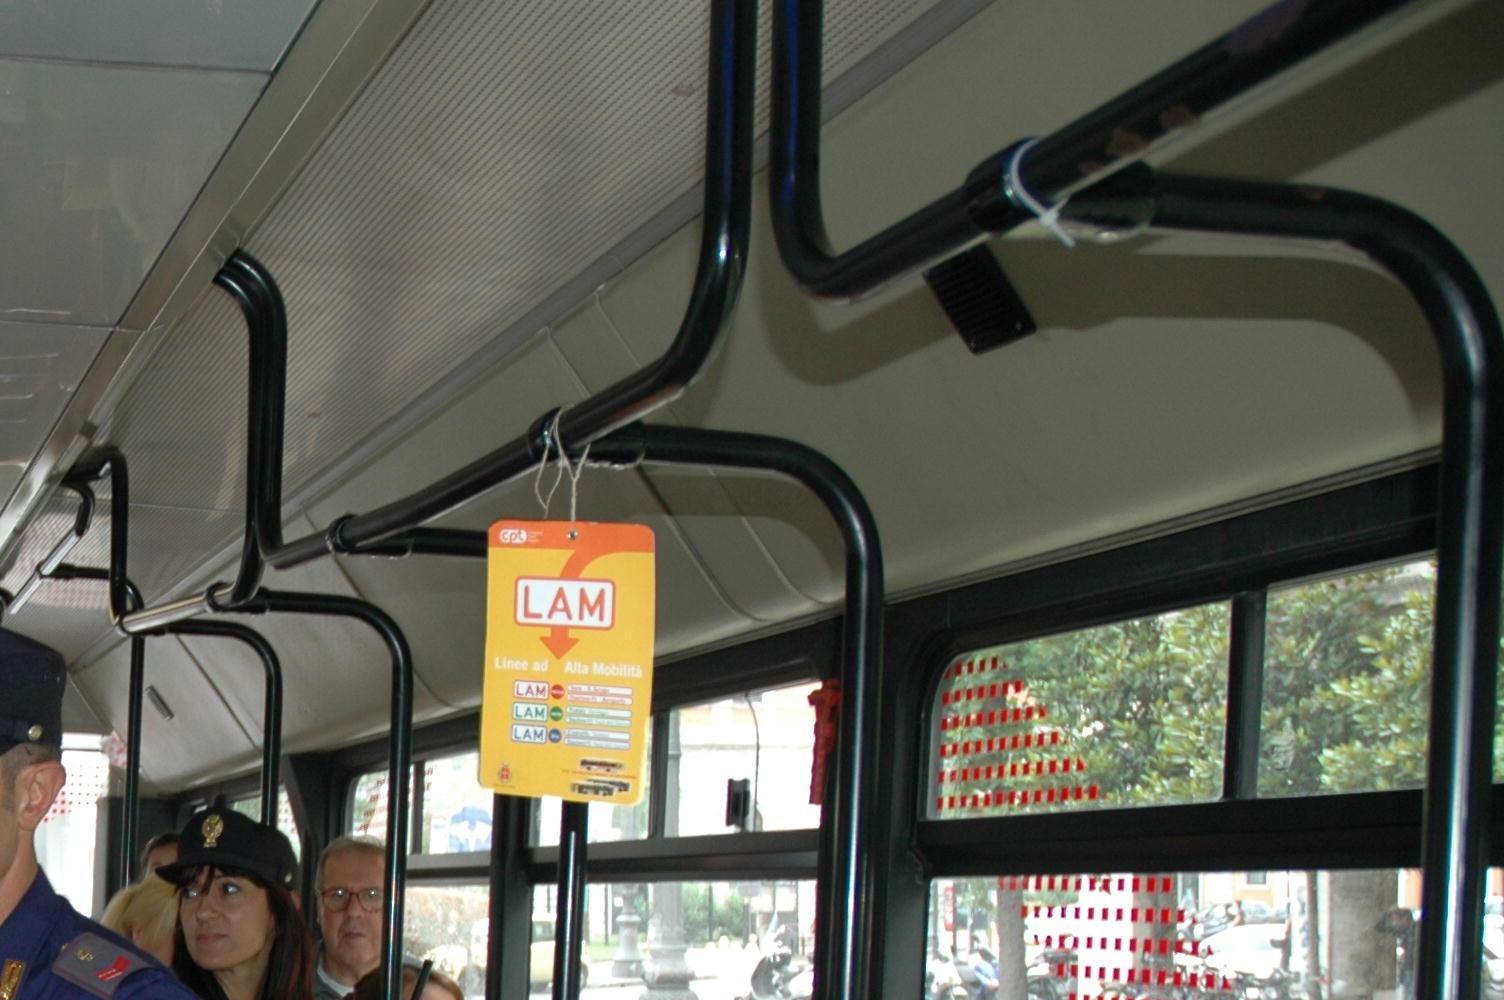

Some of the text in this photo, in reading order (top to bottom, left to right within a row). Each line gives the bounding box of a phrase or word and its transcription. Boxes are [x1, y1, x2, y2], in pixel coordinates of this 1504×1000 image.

[502, 529, 524, 544] cpt
[523, 585, 606, 622] LAM
[495, 656, 644, 679] Linee ad Alta Mobilità
[516, 684, 546, 697] LAM
[515, 705, 545, 719] LAM
[514, 727, 544, 741] LAM
